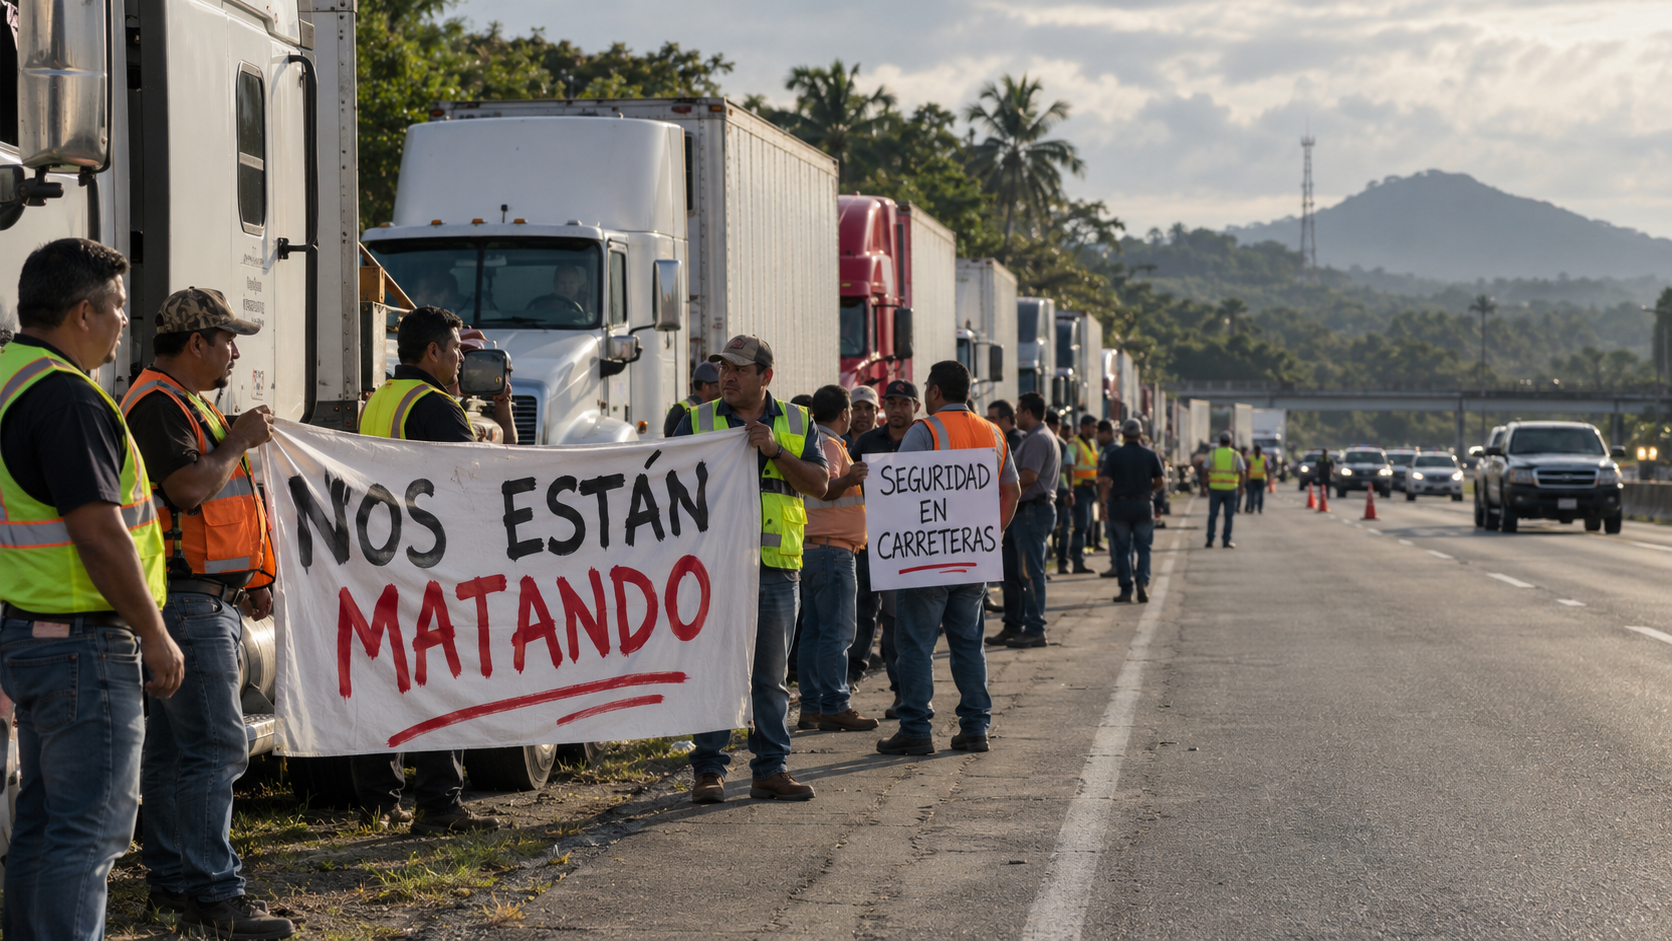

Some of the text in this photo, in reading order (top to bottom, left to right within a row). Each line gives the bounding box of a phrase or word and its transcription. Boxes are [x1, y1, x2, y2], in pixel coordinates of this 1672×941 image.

[880, 463, 991, 496] SEGURIDAD
[288, 449, 709, 574] NOS ESTÁN
[919, 497, 947, 524] EN
[877, 525, 996, 560] CARRETERAS
[337, 554, 711, 697] MATANDO
